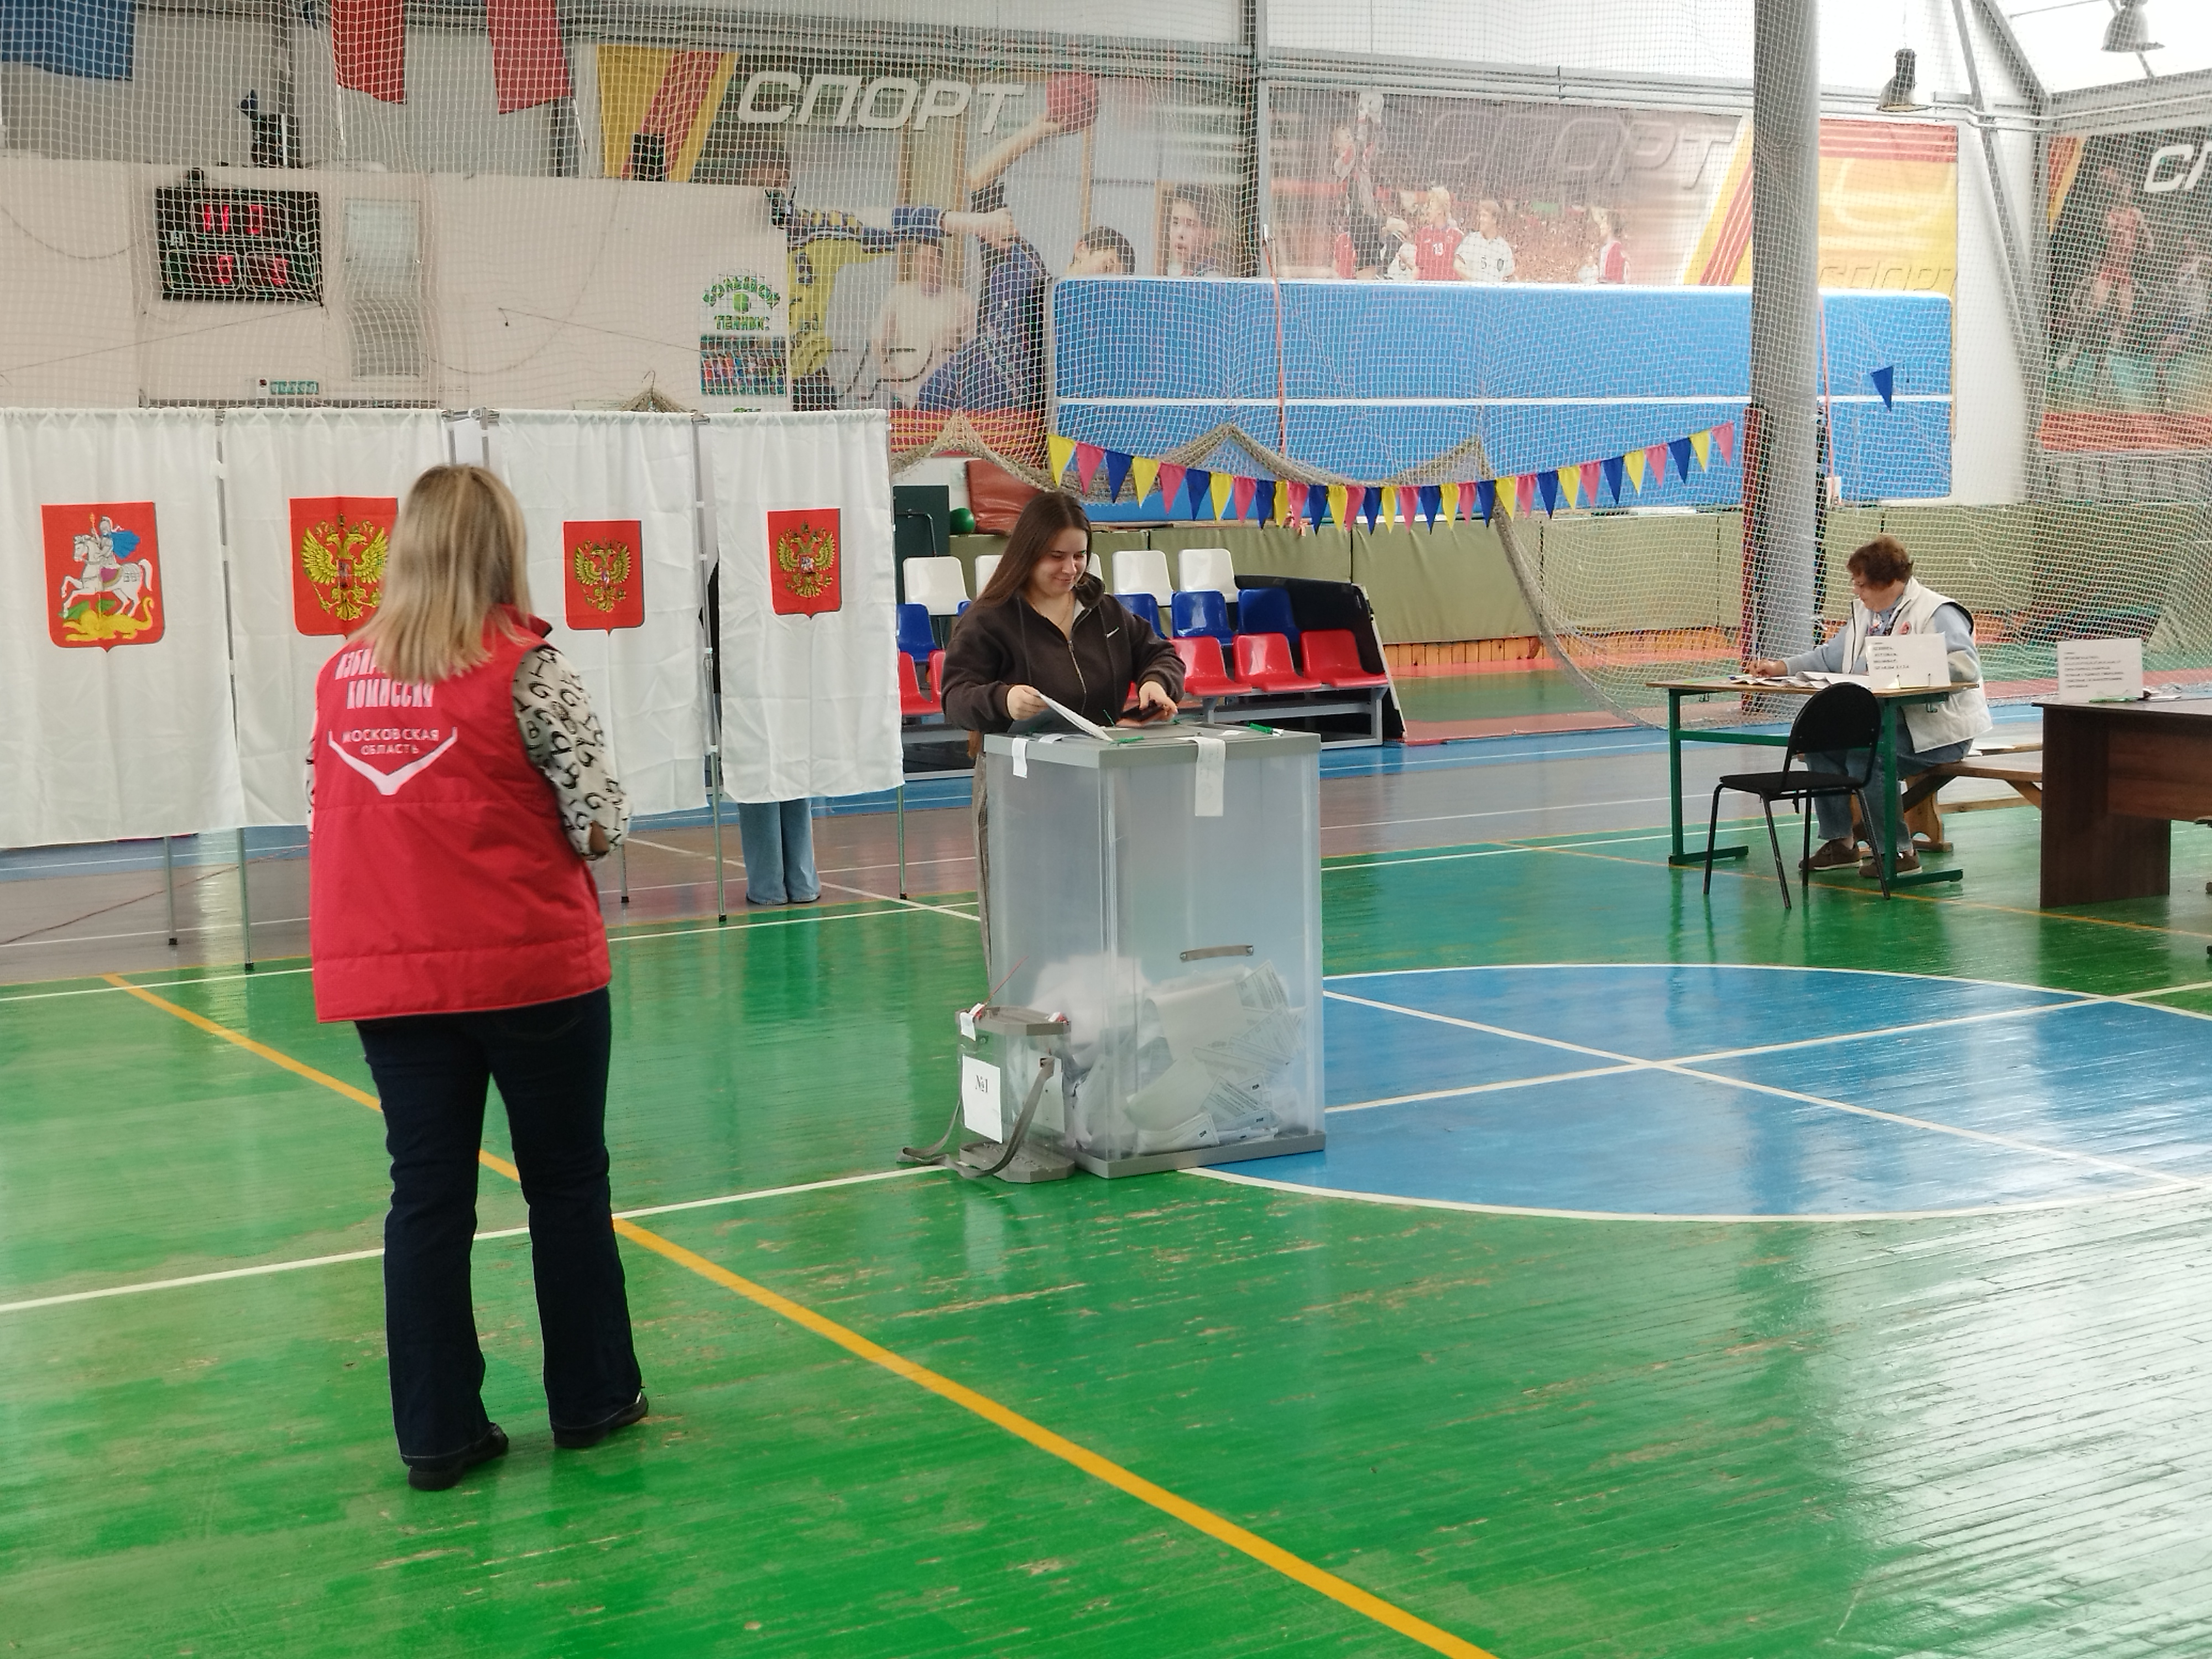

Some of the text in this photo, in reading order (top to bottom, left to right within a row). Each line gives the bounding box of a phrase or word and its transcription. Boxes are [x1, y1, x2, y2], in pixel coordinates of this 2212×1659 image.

[738, 70, 1026, 135] СПОРТ
[346, 678, 434, 709] КОМИССИЯ
[342, 728, 440, 744] МОСКОВСКАЯ
[361, 743, 420, 755] ОБЛАСТЬ
[975, 1074, 988, 1093] №1
